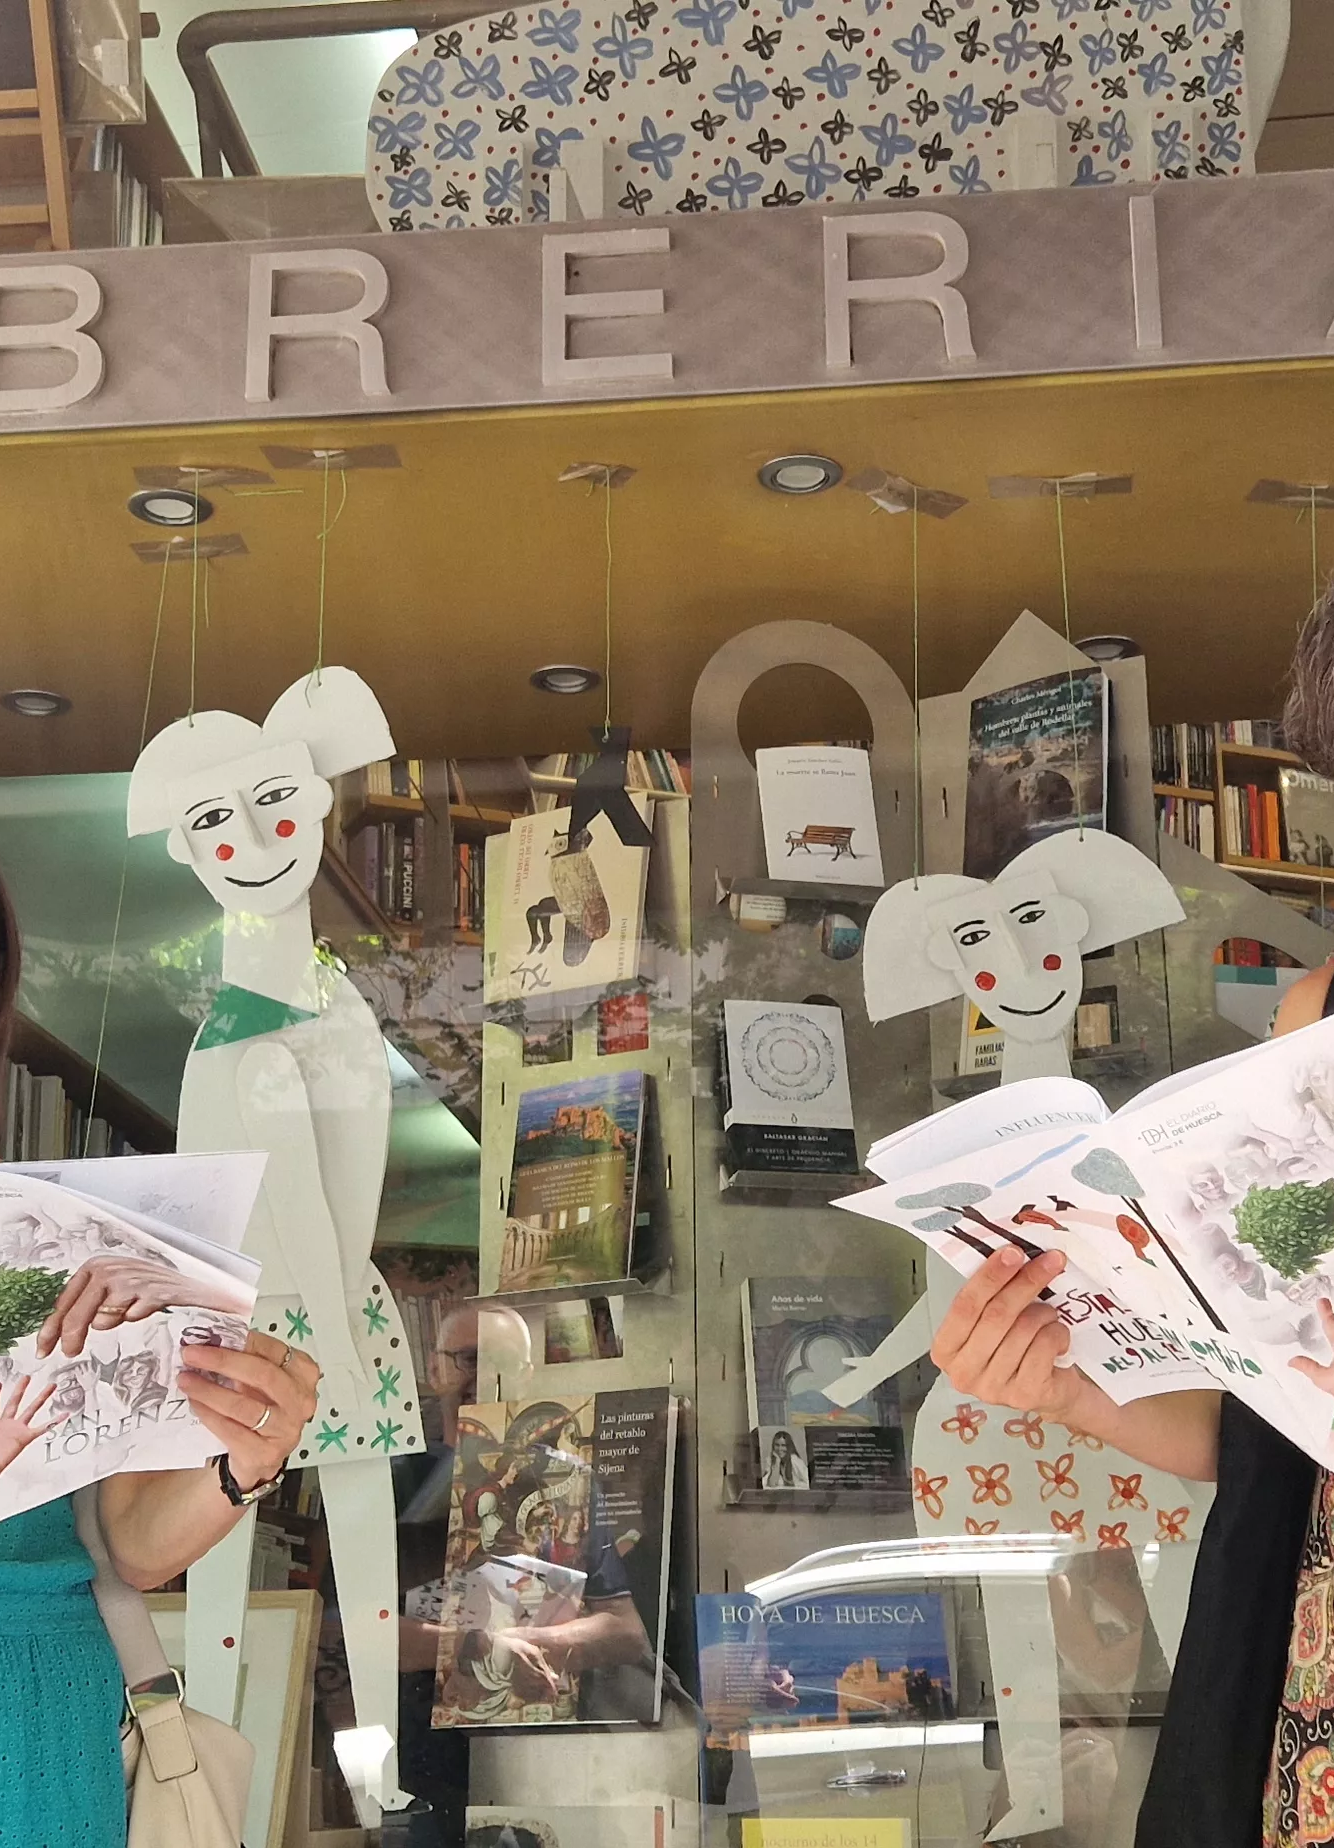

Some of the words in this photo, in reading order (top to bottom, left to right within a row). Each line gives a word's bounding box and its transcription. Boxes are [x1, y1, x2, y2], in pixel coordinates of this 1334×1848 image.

[998, 728, 1010, 738] del
[1030, 720, 1041, 730] de
[402, 861, 414, 909] PUCCINI
[1171, 1126, 1185, 1137] DE
[1185, 1111, 1223, 1131] HUESCA
[793, 1294, 804, 1303] de
[806, 1294, 823, 1303] vida
[1101, 1355, 1135, 1373] DEL
[1125, 1347, 1144, 1369] 9
[1140, 1347, 1168, 1364] AL
[45, 1408, 101, 1441] SAN
[601, 1414, 616, 1424] Las
[618, 1411, 654, 1424] pinturas
[44, 1398, 188, 1464] LORENZ
[600, 1428, 614, 1440] del
[615, 1427, 646, 1440] retablo
[598, 1447, 627, 1459] mayor
[628, 1445, 640, 1455] de
[598, 1463, 625, 1476] Sijena
[721, 1606, 784, 1624] HOYA
[795, 1606, 824, 1624] DE
[836, 1605, 926, 1624] HUESCA
[761, 1838, 818, 1848] nocturno
[822, 1834, 836, 1848] de
[840, 1834, 857, 1848] los
[863, 1834, 877, 1848] 14
